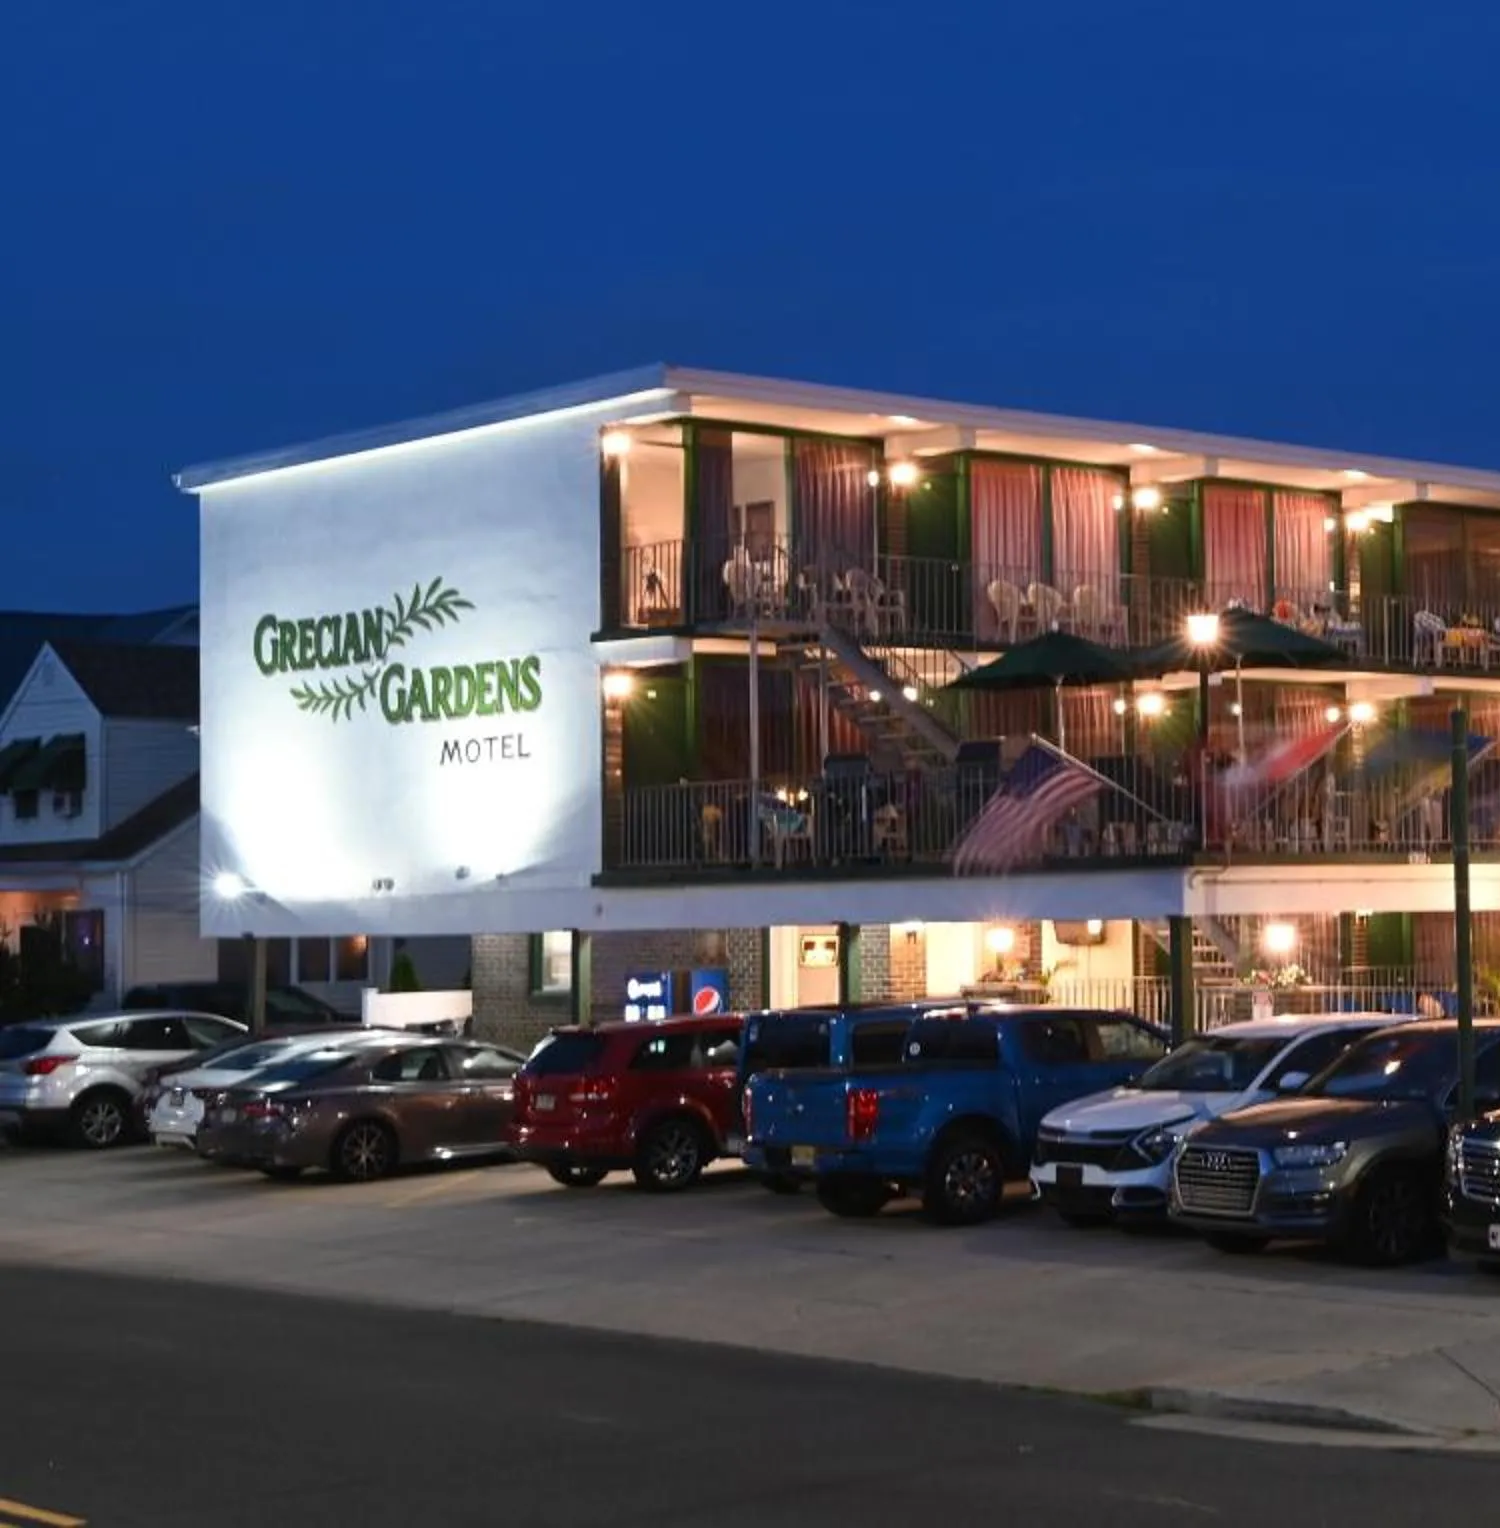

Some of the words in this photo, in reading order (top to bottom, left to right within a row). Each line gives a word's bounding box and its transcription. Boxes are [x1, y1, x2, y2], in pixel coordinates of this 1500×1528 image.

[253, 607, 387, 676] GRECIAN
[379, 655, 543, 724] GARDENS
[439, 734, 531, 766] MOTEL
